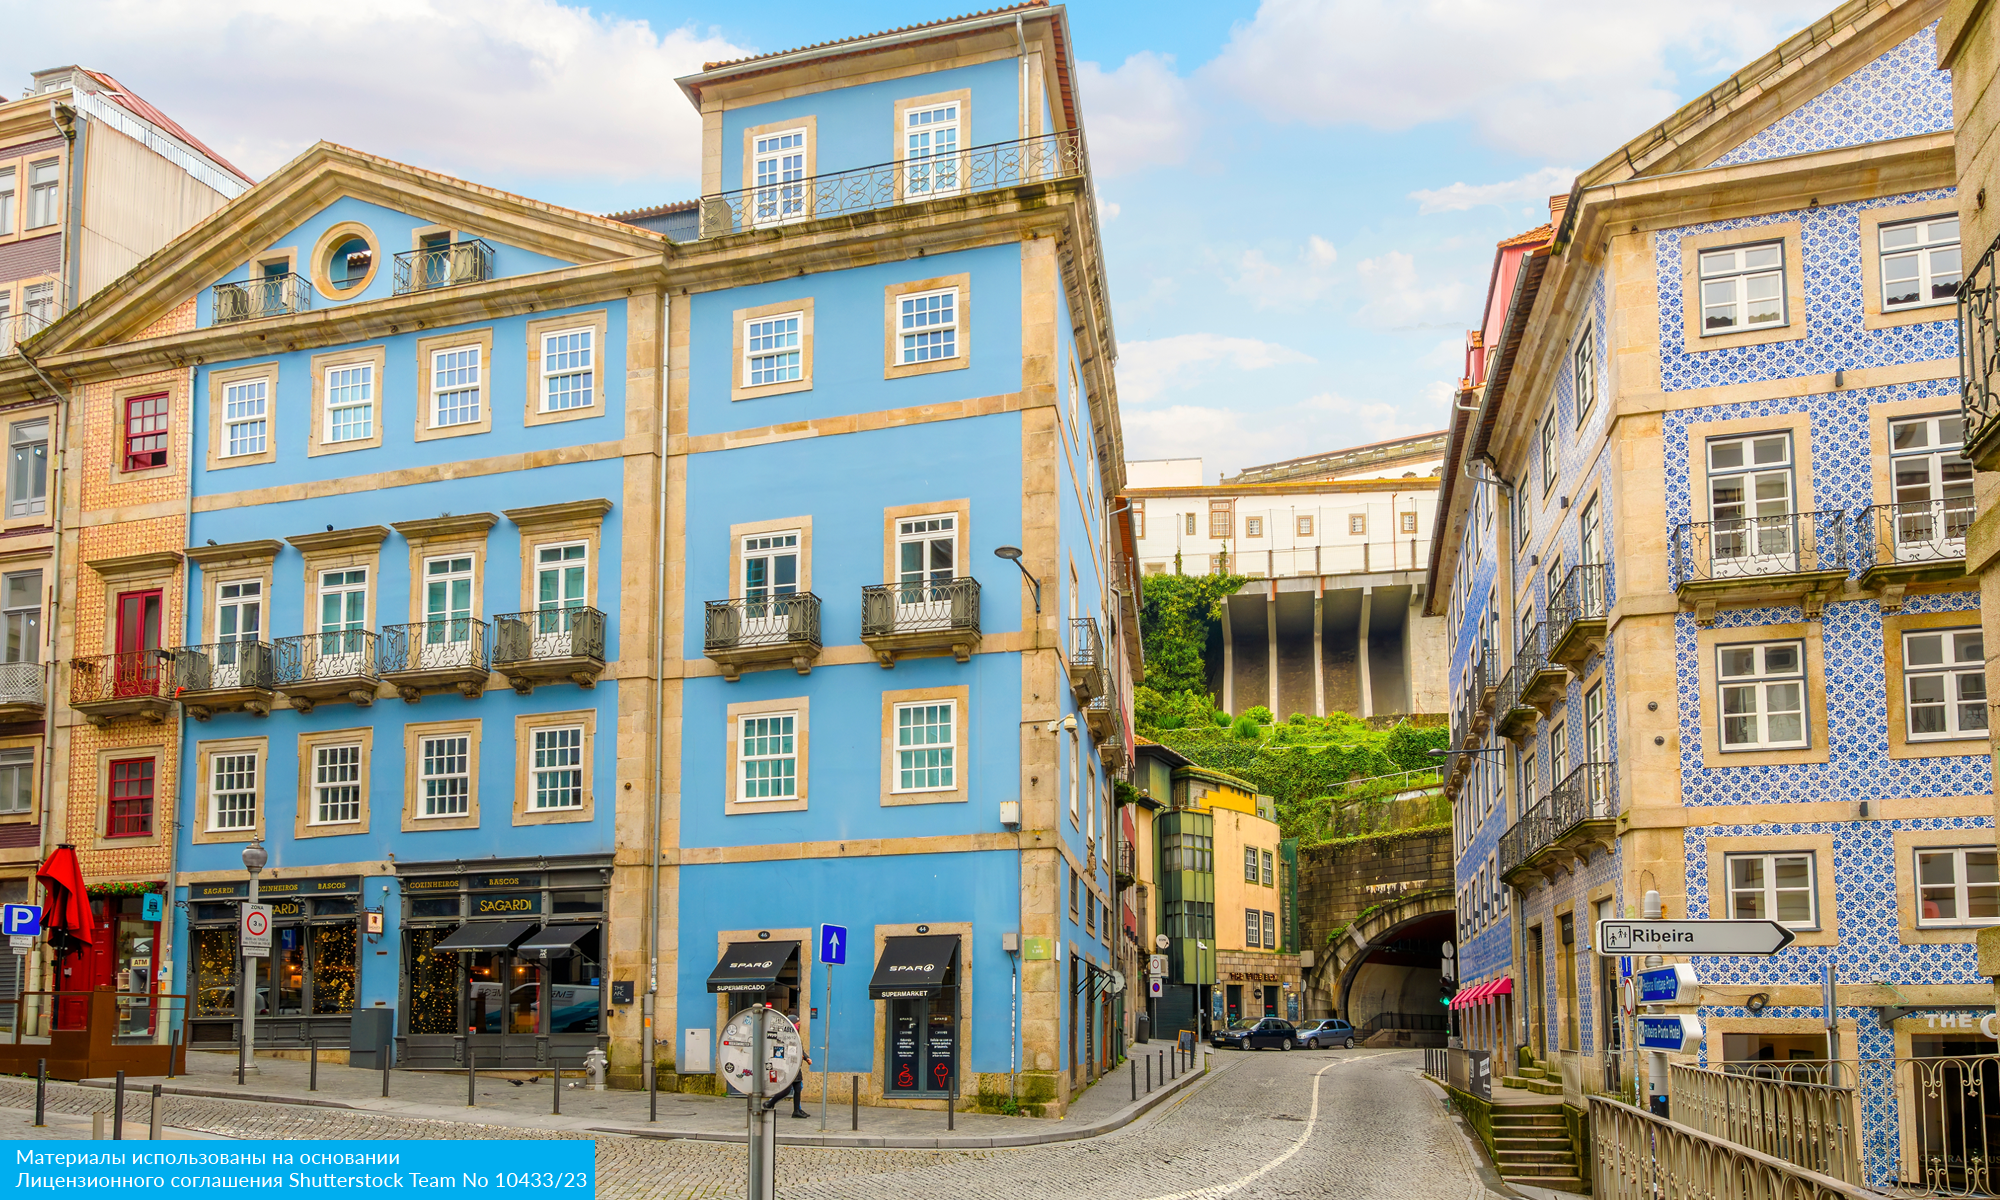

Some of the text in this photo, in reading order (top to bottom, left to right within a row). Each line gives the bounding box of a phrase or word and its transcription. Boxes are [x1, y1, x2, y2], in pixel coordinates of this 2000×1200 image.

[203, 882, 346, 895] SAGARDI OZINHEIROS BASCOS
[409, 880, 459, 888] COZINHEIROS
[272, 903, 299, 915] ARDI
[480, 898, 531, 911] SAGARDI
[11, 907, 34, 932] P
[1632, 929, 1694, 942] Ribeira
[1665, 975, 1675, 990] Porto
[881, 990, 928, 998] SUPERMARKET
[1925, 1013, 1973, 1028] THE
[1644, 1024, 1680, 1039] Ribeira Porto Hotel
